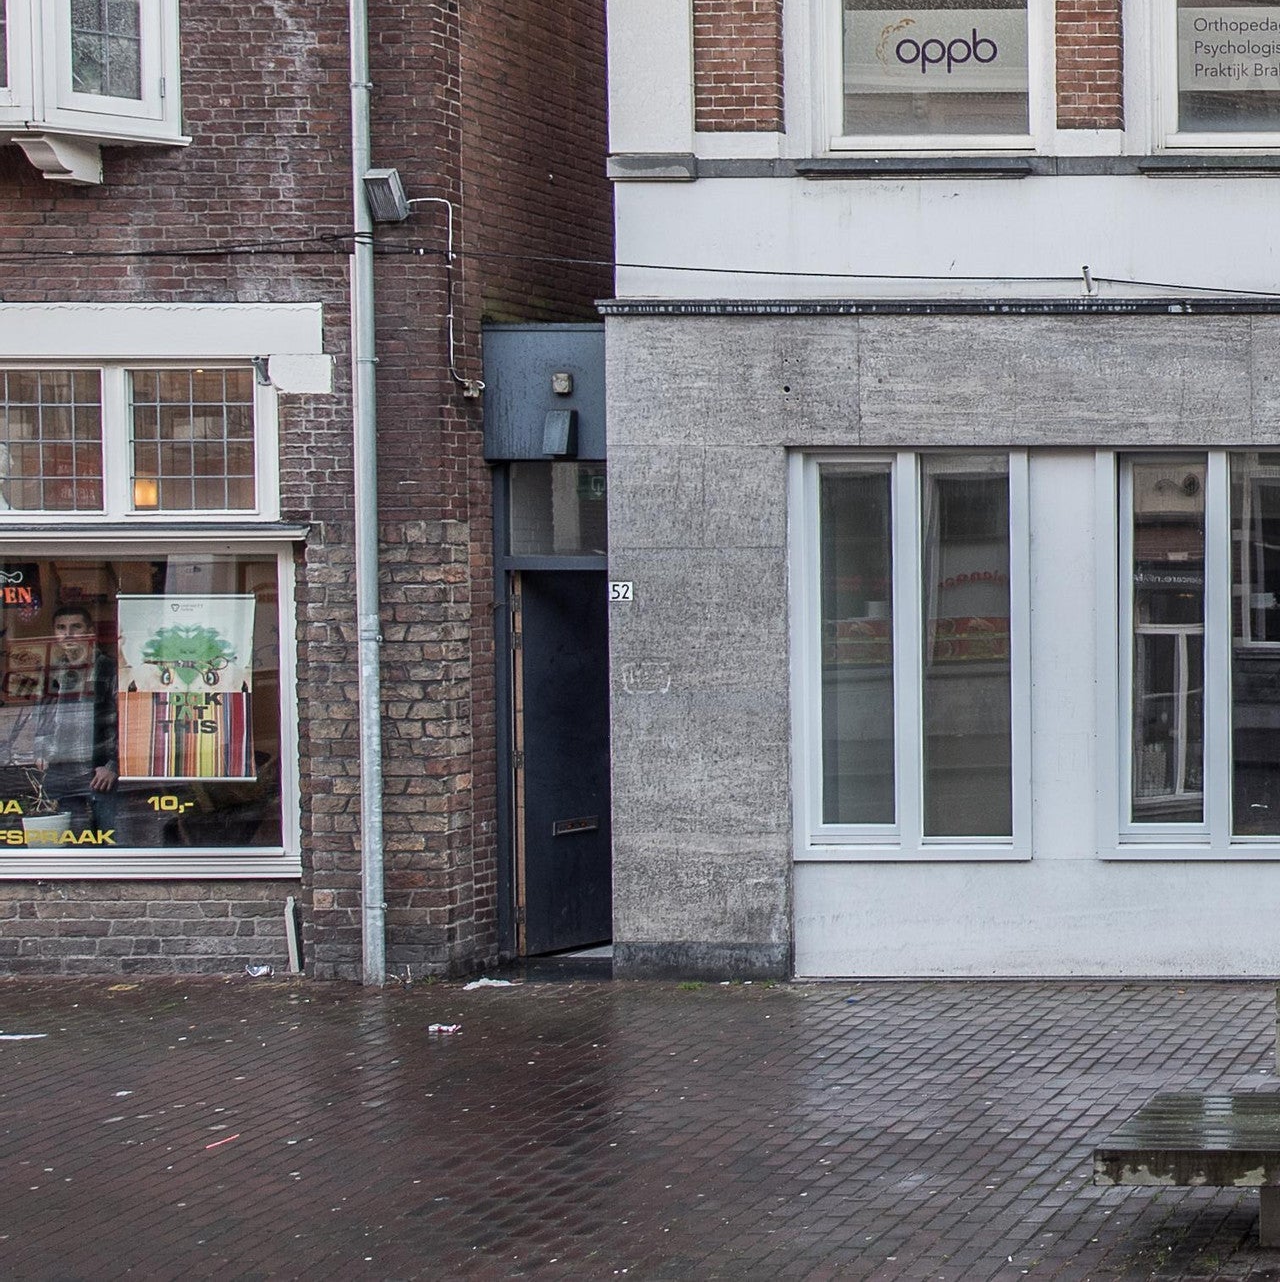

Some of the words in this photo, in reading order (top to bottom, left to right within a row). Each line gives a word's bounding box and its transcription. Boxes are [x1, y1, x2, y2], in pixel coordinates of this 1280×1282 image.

[896, 28, 998, 74] oppb
[1195, 63, 1249, 80] Praktijk
[0, 586, 33, 604] EN
[611, 584, 630, 599] 52
[158, 692, 222, 705] LOOK
[177, 706, 208, 719] AT
[158, 719, 218, 734] THIS
[147, 795, 194, 813] 10,-
